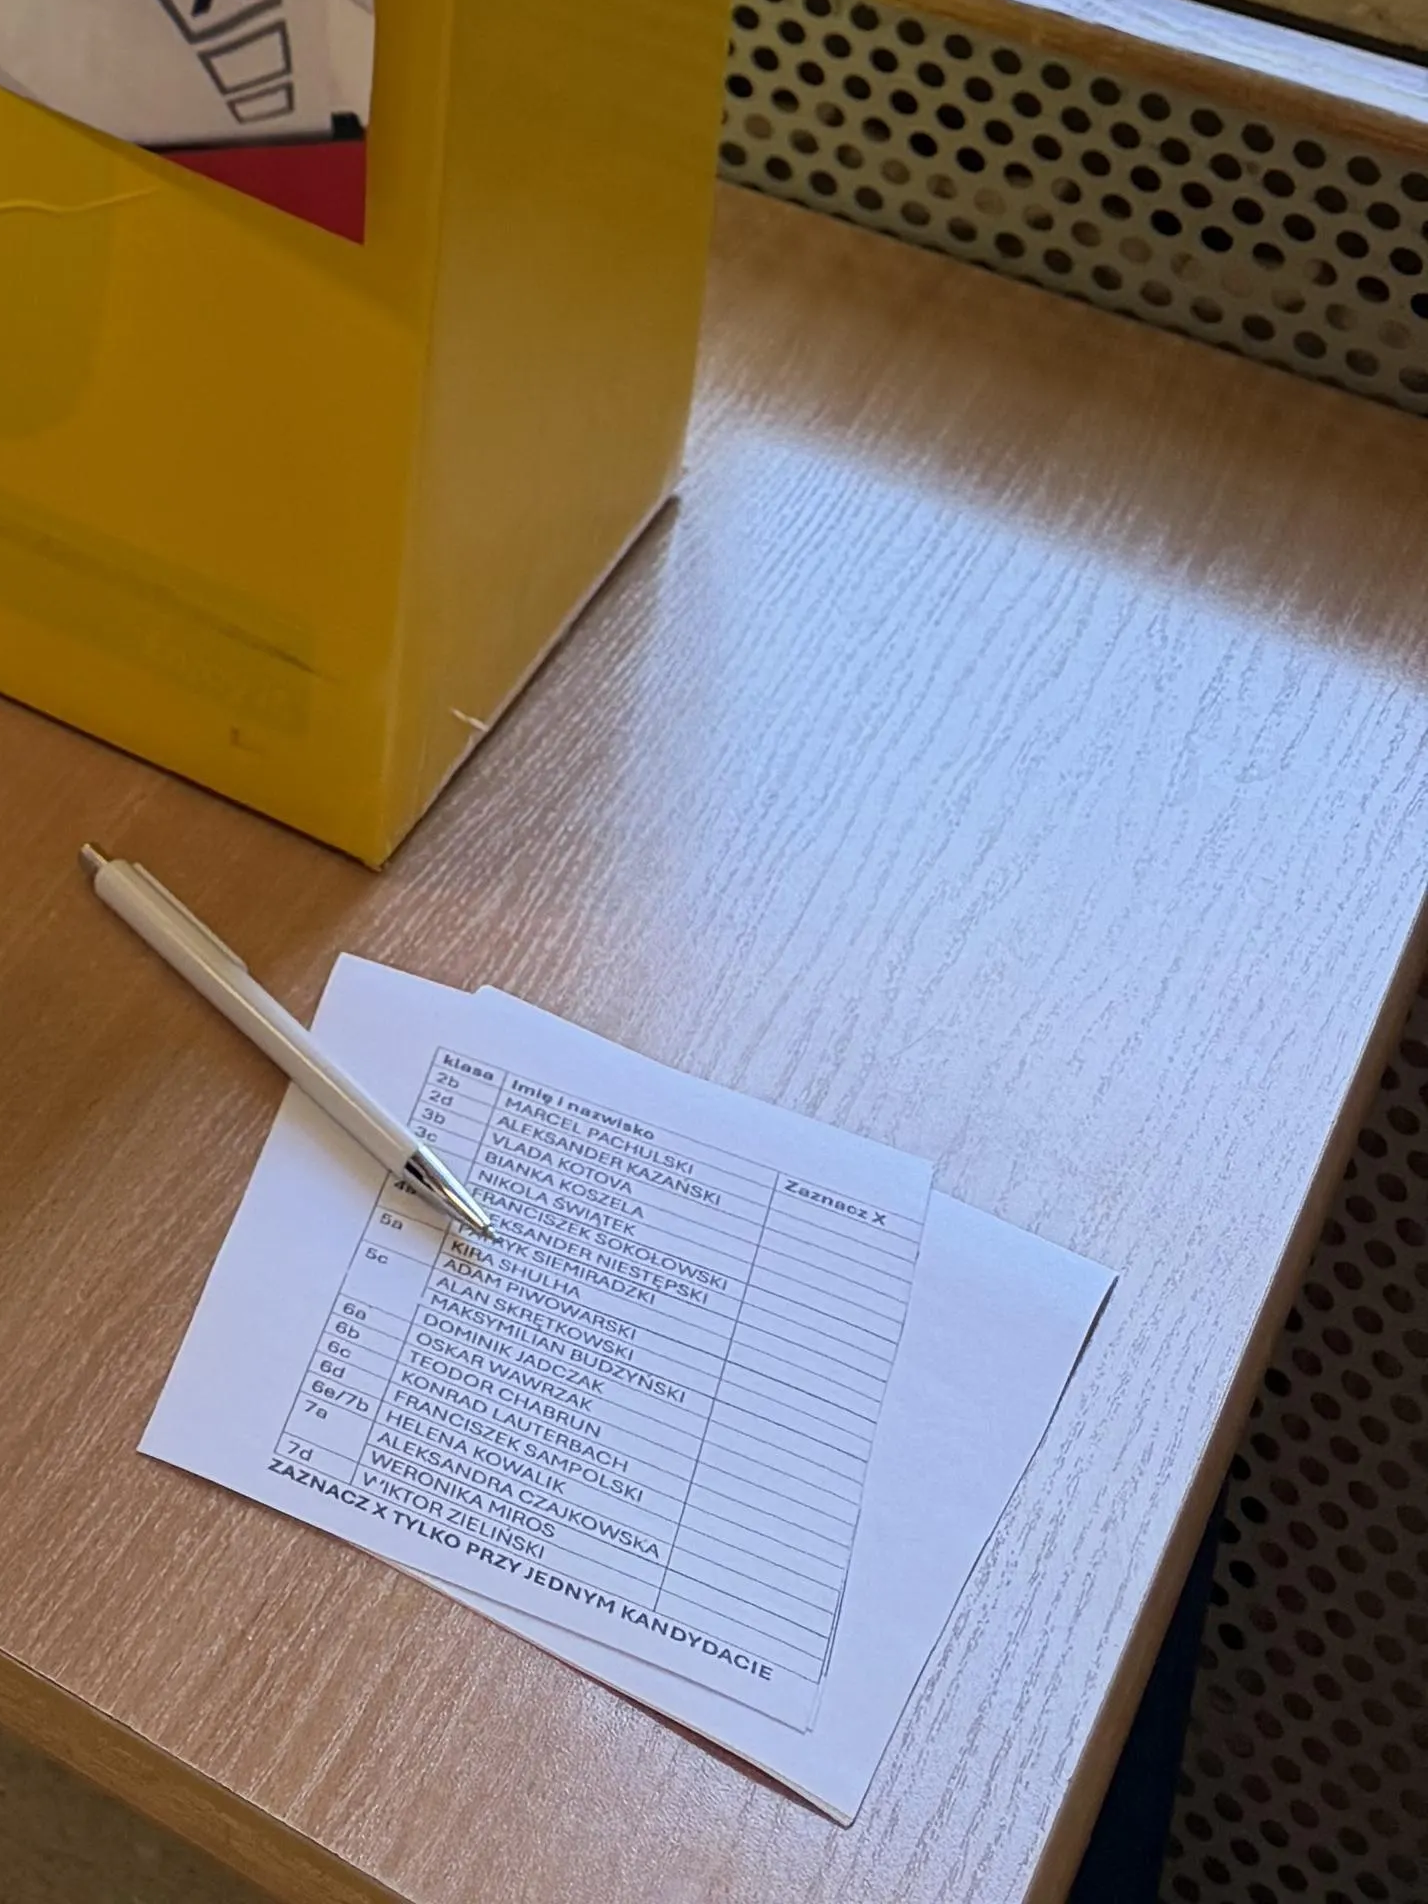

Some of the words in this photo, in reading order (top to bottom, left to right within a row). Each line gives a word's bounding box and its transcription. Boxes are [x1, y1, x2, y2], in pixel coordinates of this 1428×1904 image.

[436, 1071, 460, 1089] 2b
[444, 1053, 494, 1082] klasa
[421, 1107, 446, 1125] 3b
[428, 1089, 454, 1107] 2d
[567, 1098, 655, 1141] nazwisko
[414, 1125, 438, 1143] 3c
[496, 1115, 623, 1171] ALEKSANDER
[504, 1096, 581, 1135] MARCEL
[587, 1121, 695, 1176] PACHULSKI
[478, 1169, 548, 1205] NIKOLA
[485, 1151, 554, 1186] BIANKA
[559, 1174, 645, 1219] KOSZELA
[492, 1133, 553, 1165] VLADA
[558, 1157, 633, 1194] KOTOVA
[379, 1212, 404, 1231] 5a
[784, 1178, 868, 1220] Zaznacz
[871, 1210, 887, 1226] X
[364, 1247, 389, 1265] 5c
[472, 1187, 592, 1240] FRANCISZEK
[594, 1232, 728, 1291] SOKOŁOWSKI
[488, 1213, 592, 1261] EKSANDER
[450, 1240, 494, 1267] KIRA
[498, 1259, 580, 1299] SHULHA
[531, 1248, 656, 1305] SIEMIRADZKI
[342, 1302, 367, 1322] 6a
[430, 1294, 565, 1356] MAKSYMILIAN
[436, 1277, 491, 1305] ALAN
[494, 1298, 635, 1361] SKRĘTKOWSKI
[443, 1259, 502, 1289] ADAM
[506, 1281, 637, 1341] PIWOWARSKI
[327, 1340, 352, 1359] 6c
[335, 1321, 361, 1340] 6b
[423, 1313, 514, 1359] DOMINIK
[515, 1350, 605, 1394] JADCZAK
[311, 1380, 370, 1413] 6e/7b
[320, 1360, 346, 1379] 6d
[409, 1350, 494, 1395] TEODOR
[498, 1388, 602, 1438] CHABRUN
[416, 1332, 485, 1369] OSKAR
[489, 1360, 594, 1412] WAWRZAK
[304, 1399, 329, 1420] 7a
[401, 1370, 488, 1415] KONRAD
[492, 1407, 629, 1473] LAUTERBACH
[287, 1440, 314, 1462] 7d
[386, 1410, 468, 1455] HELENA
[472, 1446, 567, 1495] KOWALIK
[393, 1390, 521, 1452] FRANCISZEK
[523, 1443, 644, 1502] SAMPOLSKI
[371, 1450, 483, 1509] WERONIKA
[488, 1500, 556, 1538] MIROS
[377, 1431, 514, 1498] ALEKSANDRA
[518, 1490, 660, 1559] CZAJKOWSKA
[446, 1508, 545, 1560] ZIELIŃSKI
[268, 1457, 371, 1512] ZAZNACZ
[371, 1502, 388, 1520] X
[393, 1510, 461, 1550] TYLKO
[465, 1541, 522, 1574] PRZY
[524, 1567, 616, 1614] JEDNYM
[621, 1604, 775, 1681] KANDYDACIE
